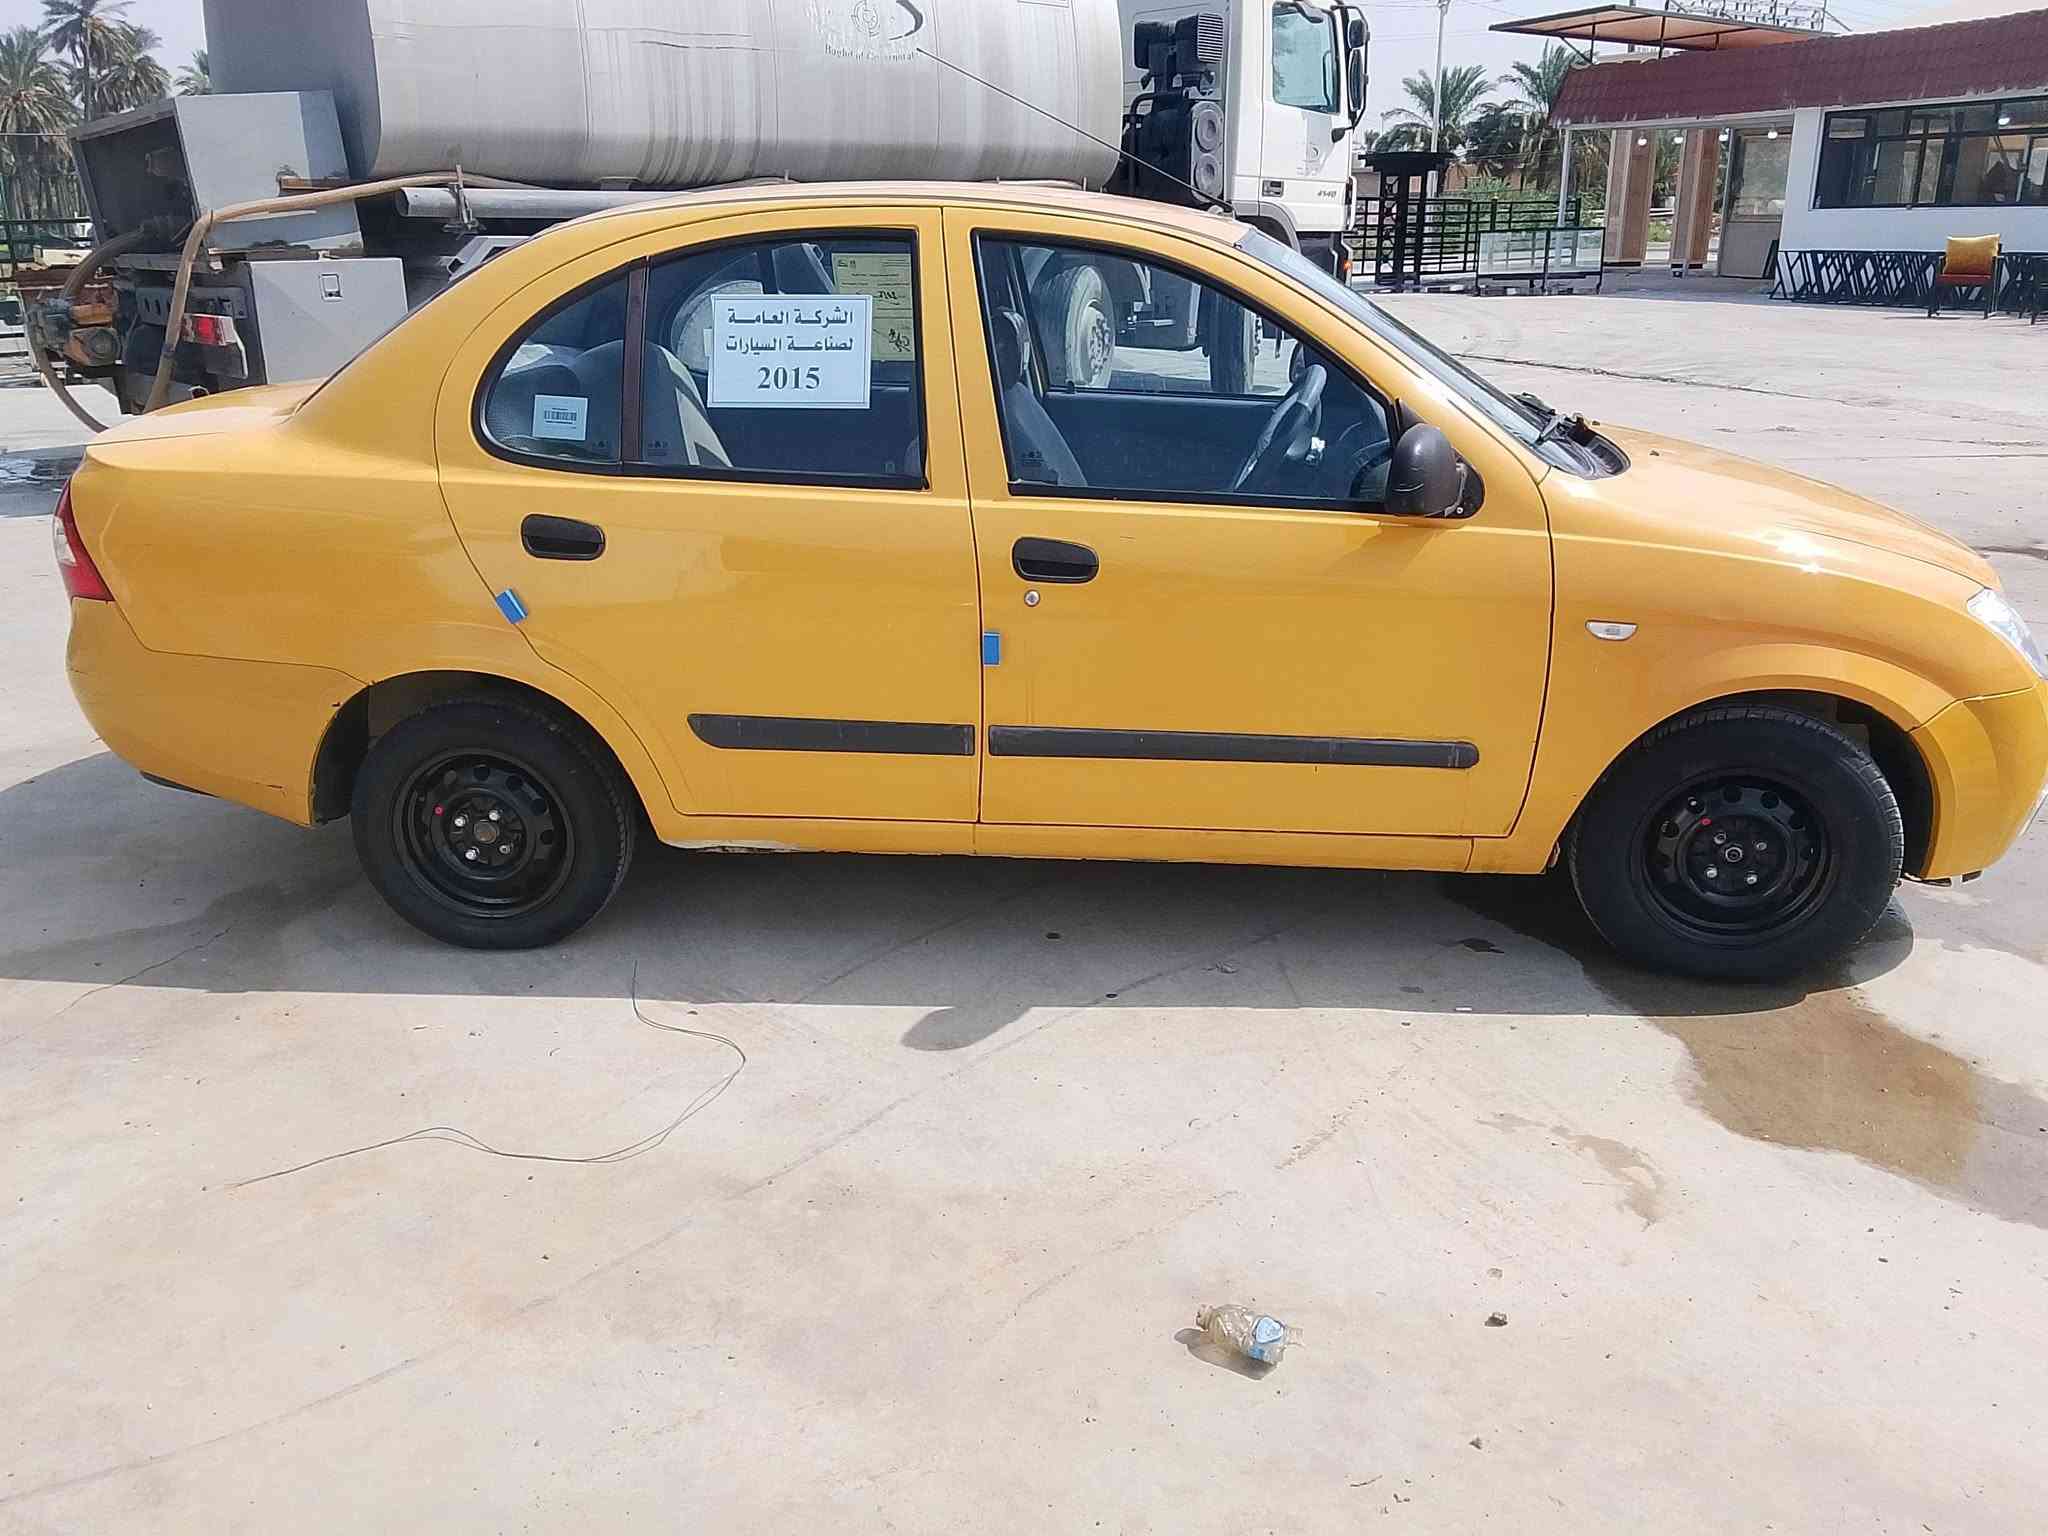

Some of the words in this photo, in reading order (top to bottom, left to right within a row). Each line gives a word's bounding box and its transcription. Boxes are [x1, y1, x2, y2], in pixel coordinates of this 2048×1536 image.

[727, 308, 789, 326] العامة
[794, 306, 853, 329] الشركة
[725, 335, 782, 356] السيارات
[787, 335, 853, 352] لصناعة
[757, 366, 821, 390] 2015
